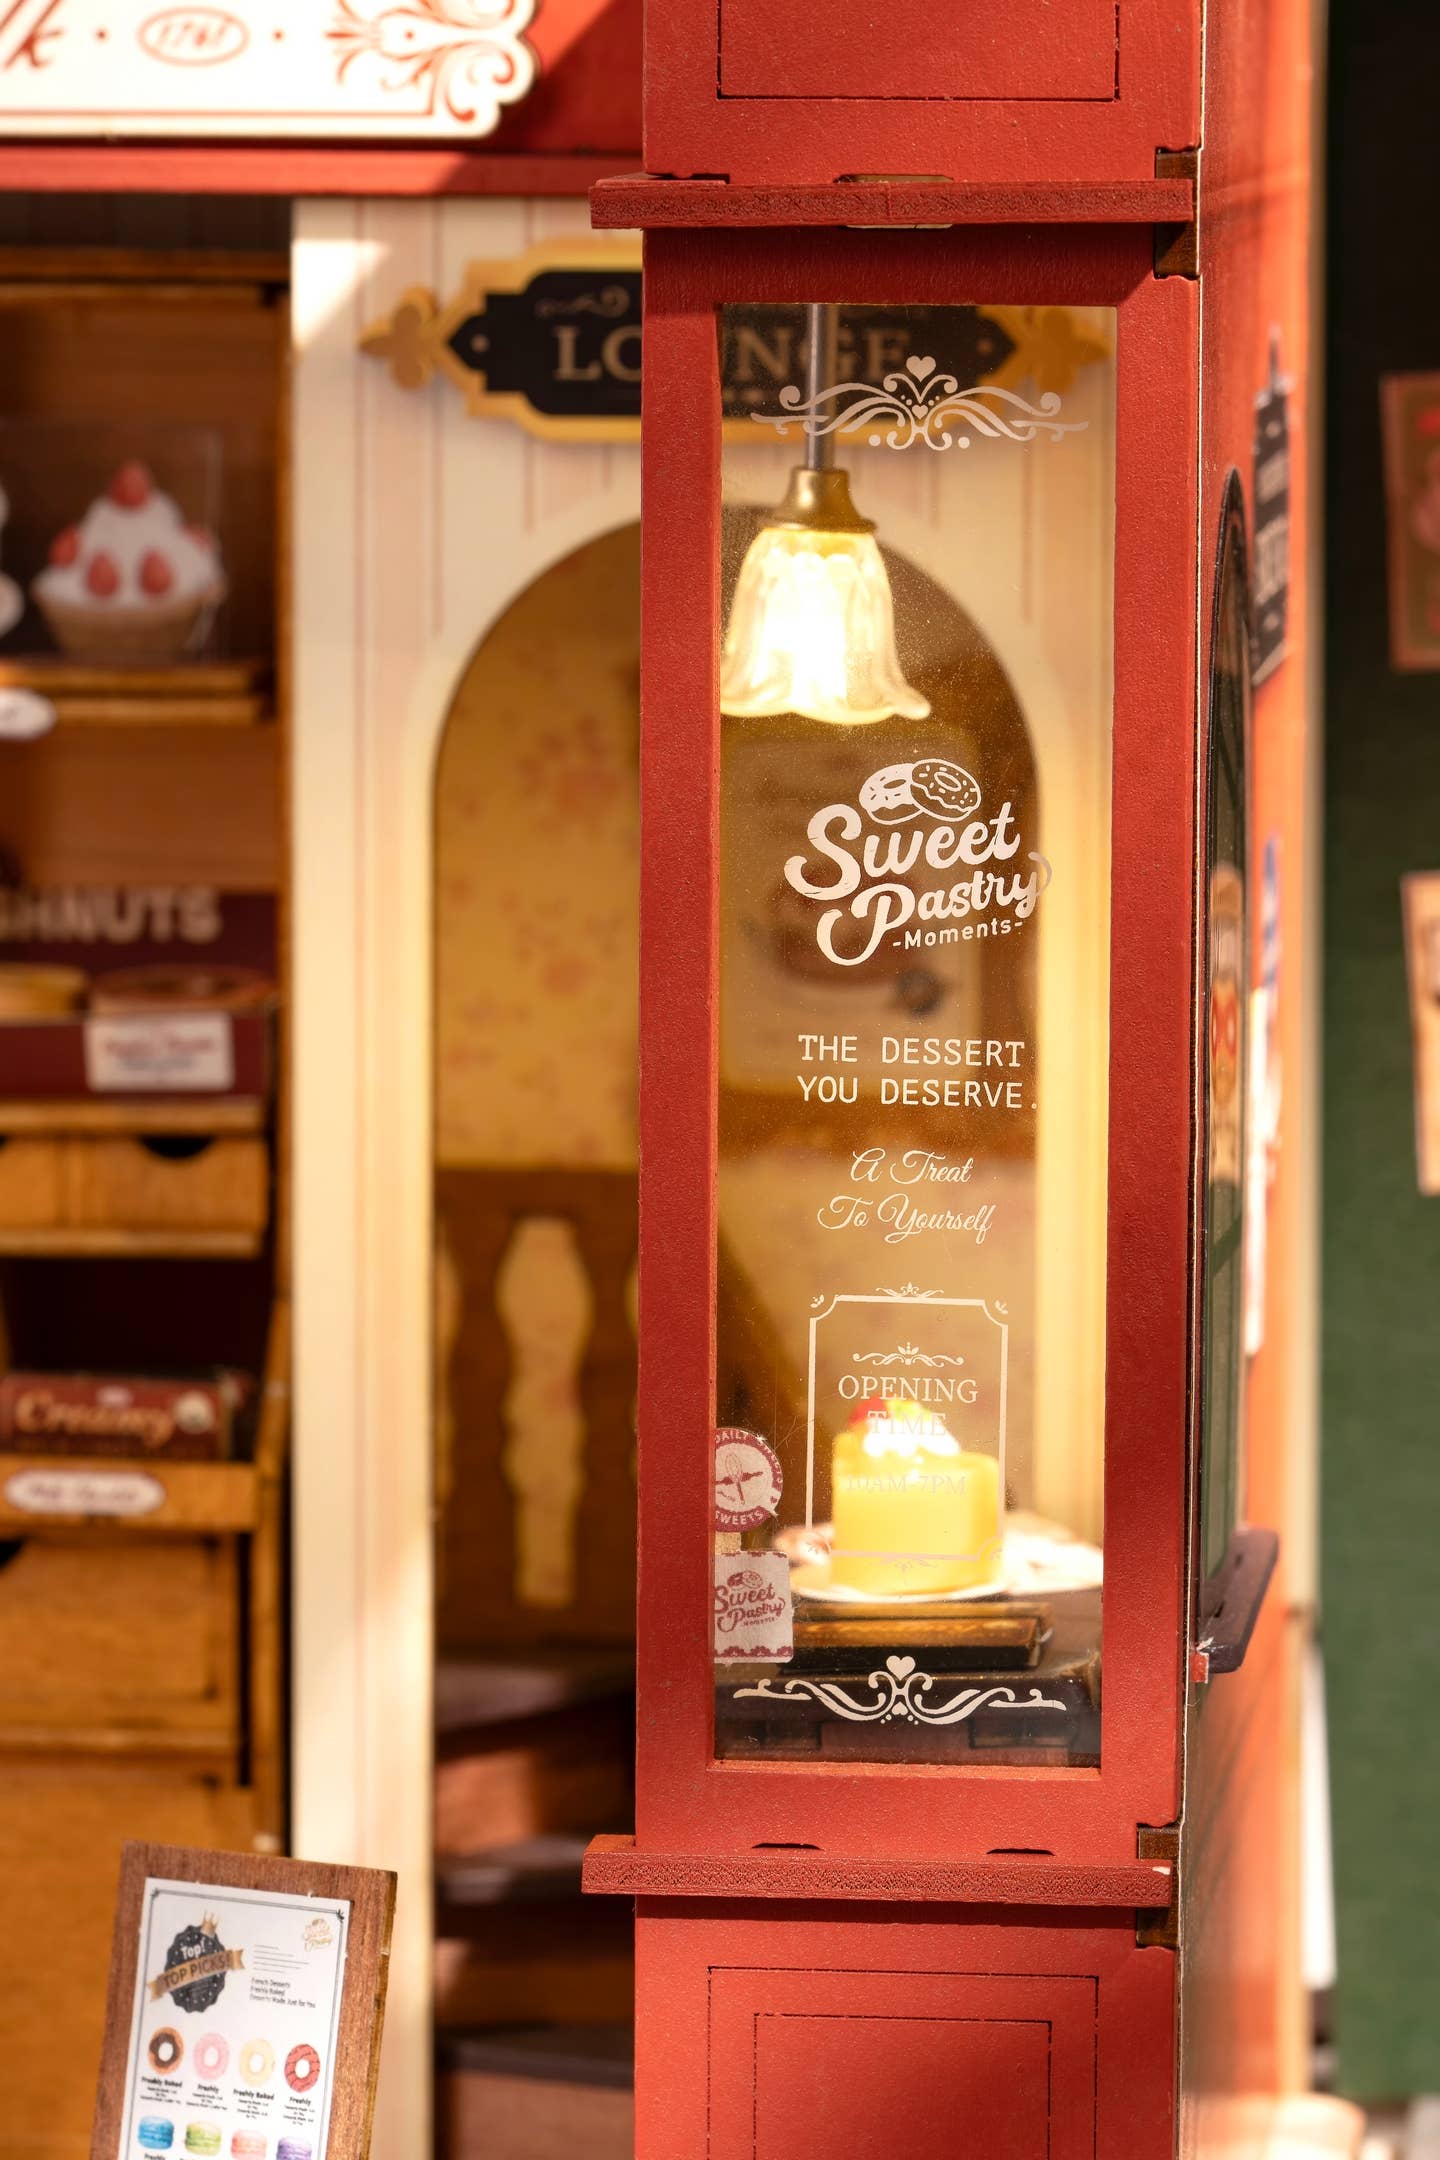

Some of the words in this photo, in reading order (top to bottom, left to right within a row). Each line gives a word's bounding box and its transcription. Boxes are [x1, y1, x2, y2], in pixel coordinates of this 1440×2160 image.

[553, 324, 912, 382] LONGE
[784, 801, 1021, 900] Sweet
[816, 851, 1053, 966] Pastry
[797, 1034, 859, 1063] THE
[881, 1036, 1025, 1068] DESSERT
[796, 1075, 859, 1104] YOU
[849, 1147, 886, 1183] A
[889, 1149, 974, 1185] Treat
[817, 1194, 874, 1230] To
[877, 1192, 997, 1245] Yourself
[838, 1374, 979, 1404] OPENING
[867, 1410, 947, 1437] TIME
[715, 1582, 776, 1614] Sweet
[717, 1597, 786, 1633] Pastry
